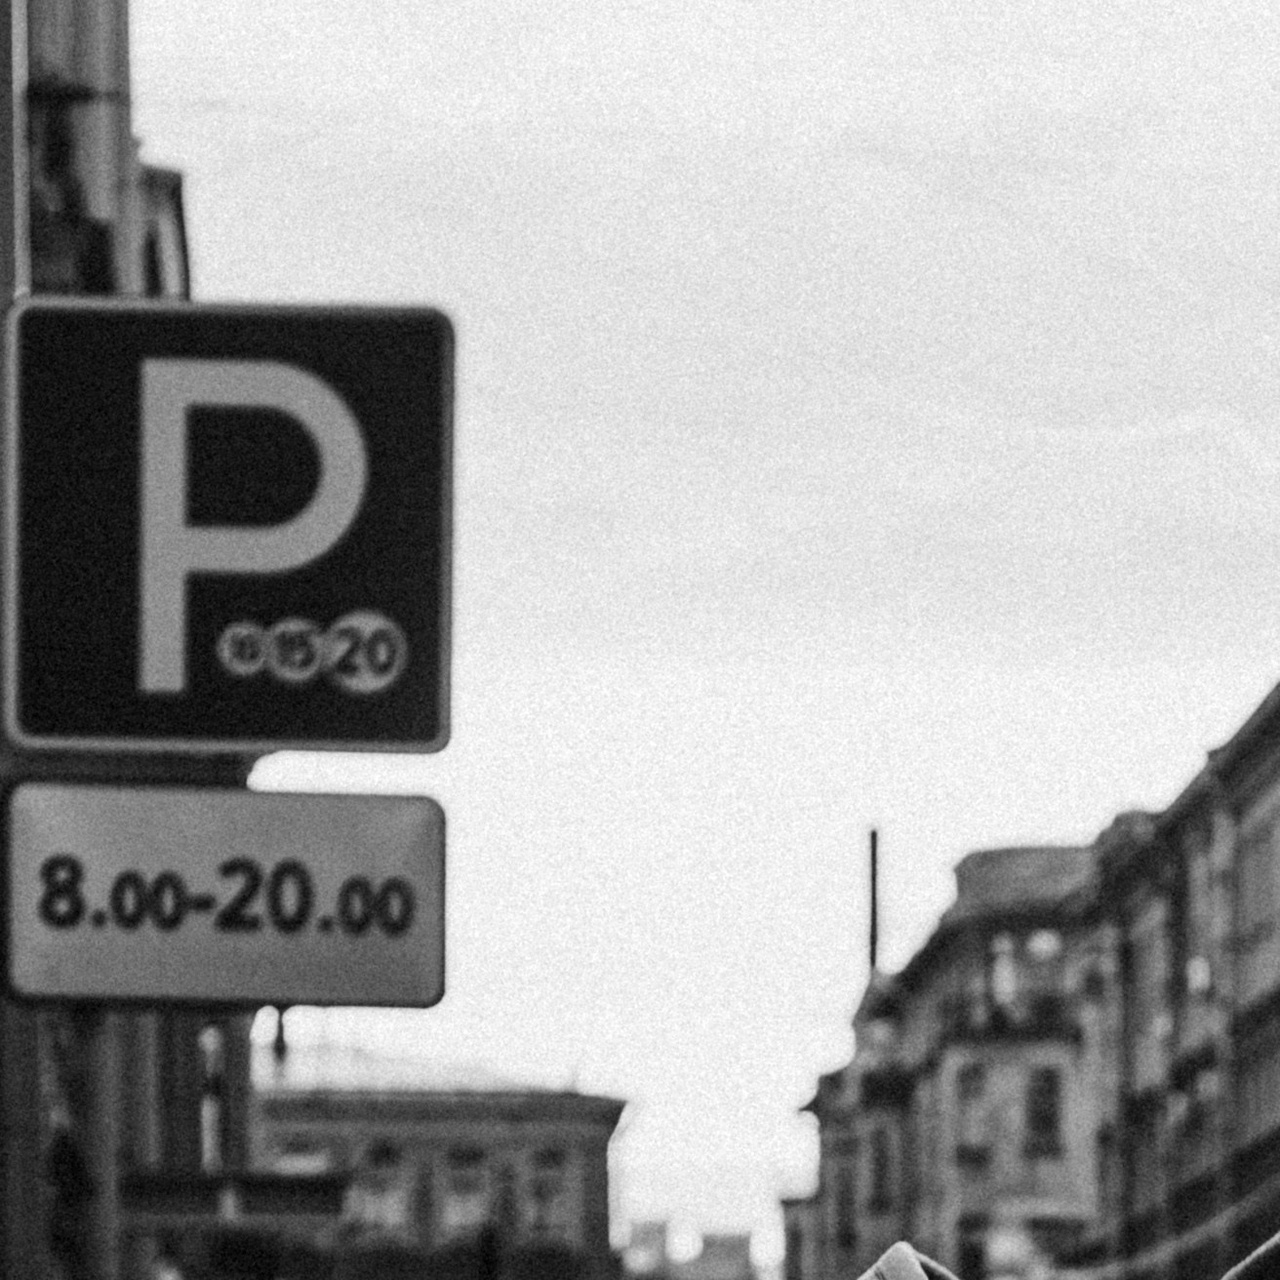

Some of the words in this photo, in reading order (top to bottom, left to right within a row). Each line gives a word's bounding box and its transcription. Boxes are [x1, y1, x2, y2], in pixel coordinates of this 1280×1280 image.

[138, 356, 368, 693] P
[335, 626, 397, 676] 20
[39, 855, 416, 936] 8.00-20.00
